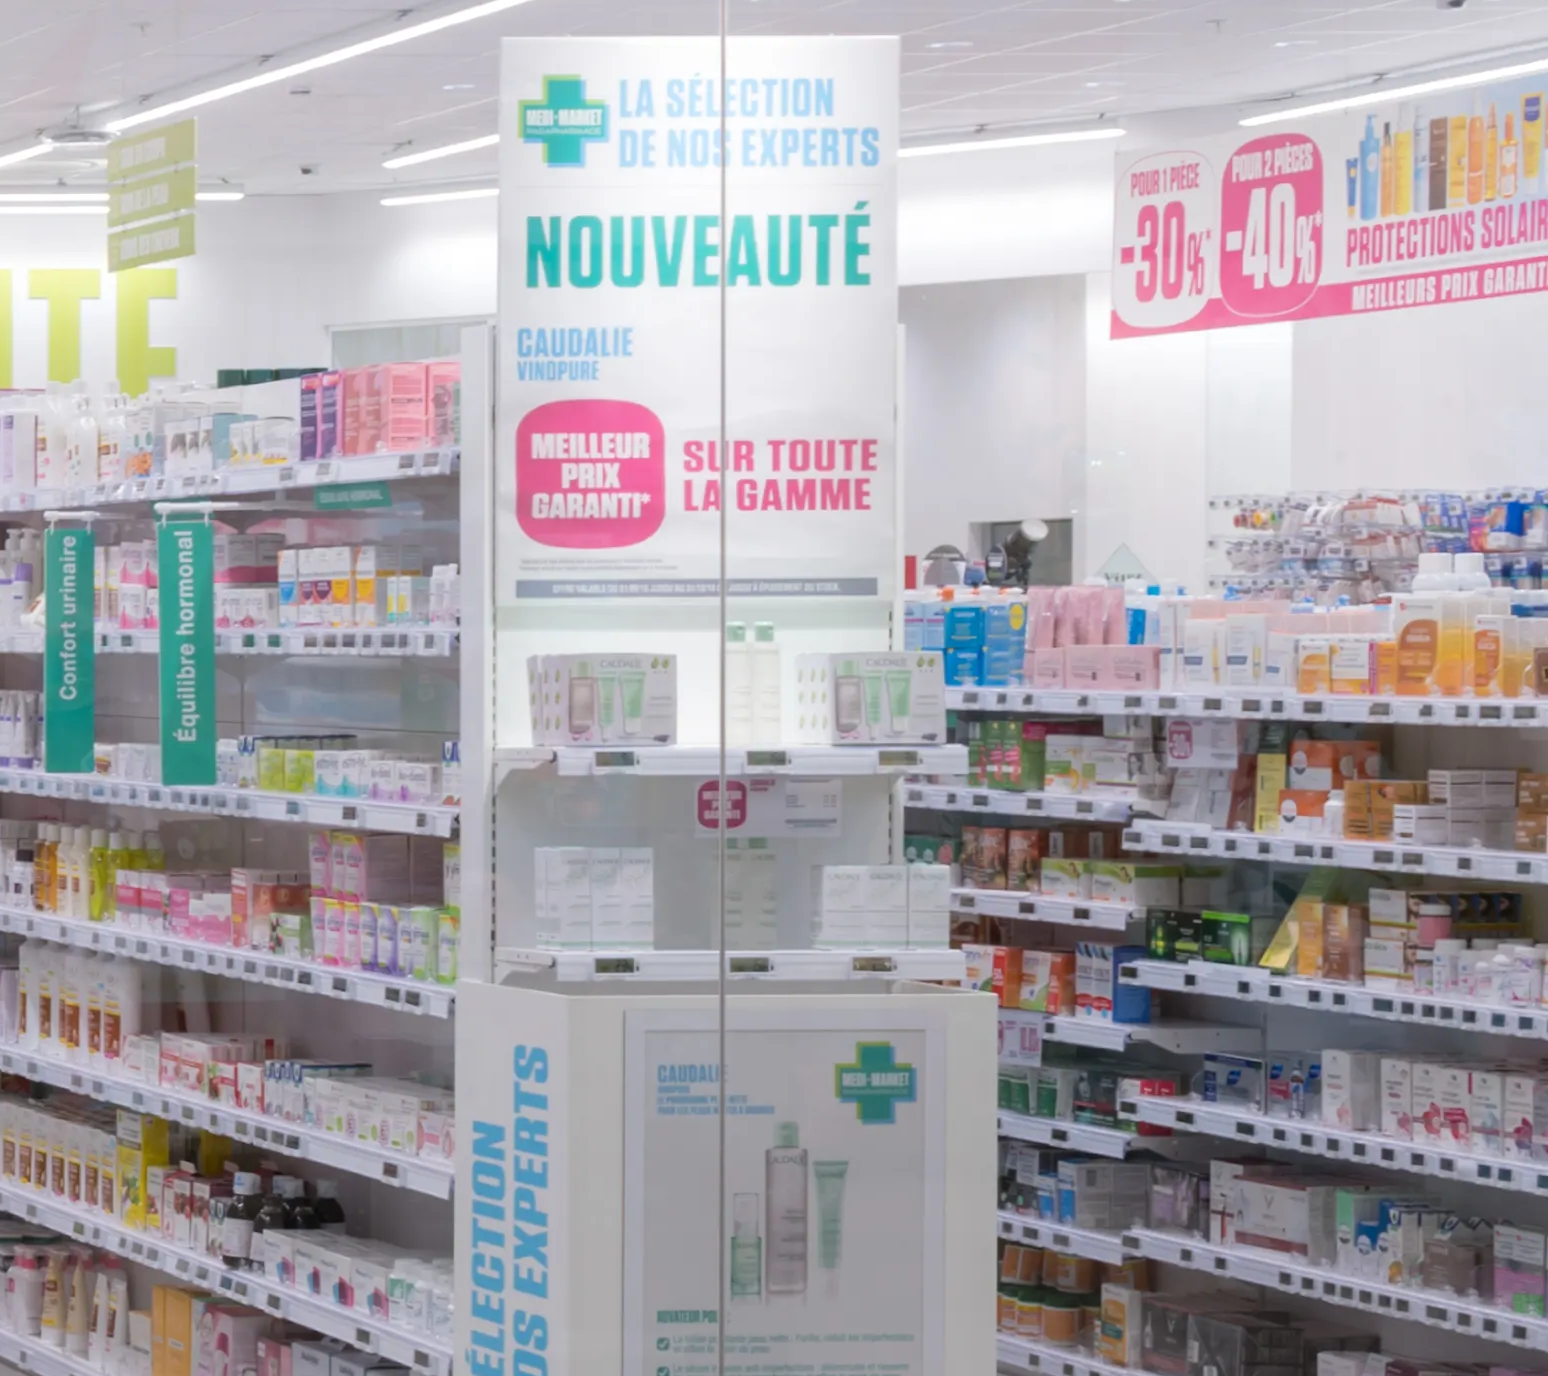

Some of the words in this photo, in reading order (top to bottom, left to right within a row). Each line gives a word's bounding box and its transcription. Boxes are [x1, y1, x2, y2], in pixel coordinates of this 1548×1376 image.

[619, 79, 654, 118] LA
[666, 73, 834, 117] SÉLECTION
[526, 108, 602, 126] MEDI-MARKET
[619, 130, 656, 167] DE
[668, 129, 724, 167] NOS
[742, 128, 879, 167] EXPERTS
[1232, 153, 1263, 182] POUR
[1264, 153, 1272, 176] 2
[1275, 142, 1314, 174] PIÈCES
[1131, 170, 1159, 198] POUR
[1170, 161, 1200, 190] PIÈCE
[526, 201, 871, 288] NOUVEAUTÉ
[1347, 210, 1474, 267] PROTECTIONS
[1353, 276, 1436, 310] MEILLEURS
[1441, 273, 1478, 301] PRIX
[518, 328, 632, 358] CAUDALIE
[518, 361, 600, 380] VINOPURE
[532, 433, 650, 459] MEILLEUR
[684, 440, 753, 472] SUR
[767, 439, 877, 471] TOUTE
[562, 463, 621, 489] PRIX
[684, 479, 722, 511] LA
[737, 479, 871, 511] GAMME
[59, 537, 77, 613] urinaire
[174, 530, 195, 634] hormonal
[60, 621, 77, 700] Confort
[173, 643, 199, 742] Équilibre
[842, 1073, 909, 1086] MEDI-MARKET
[514, 1045, 548, 1299] EXPERTS
